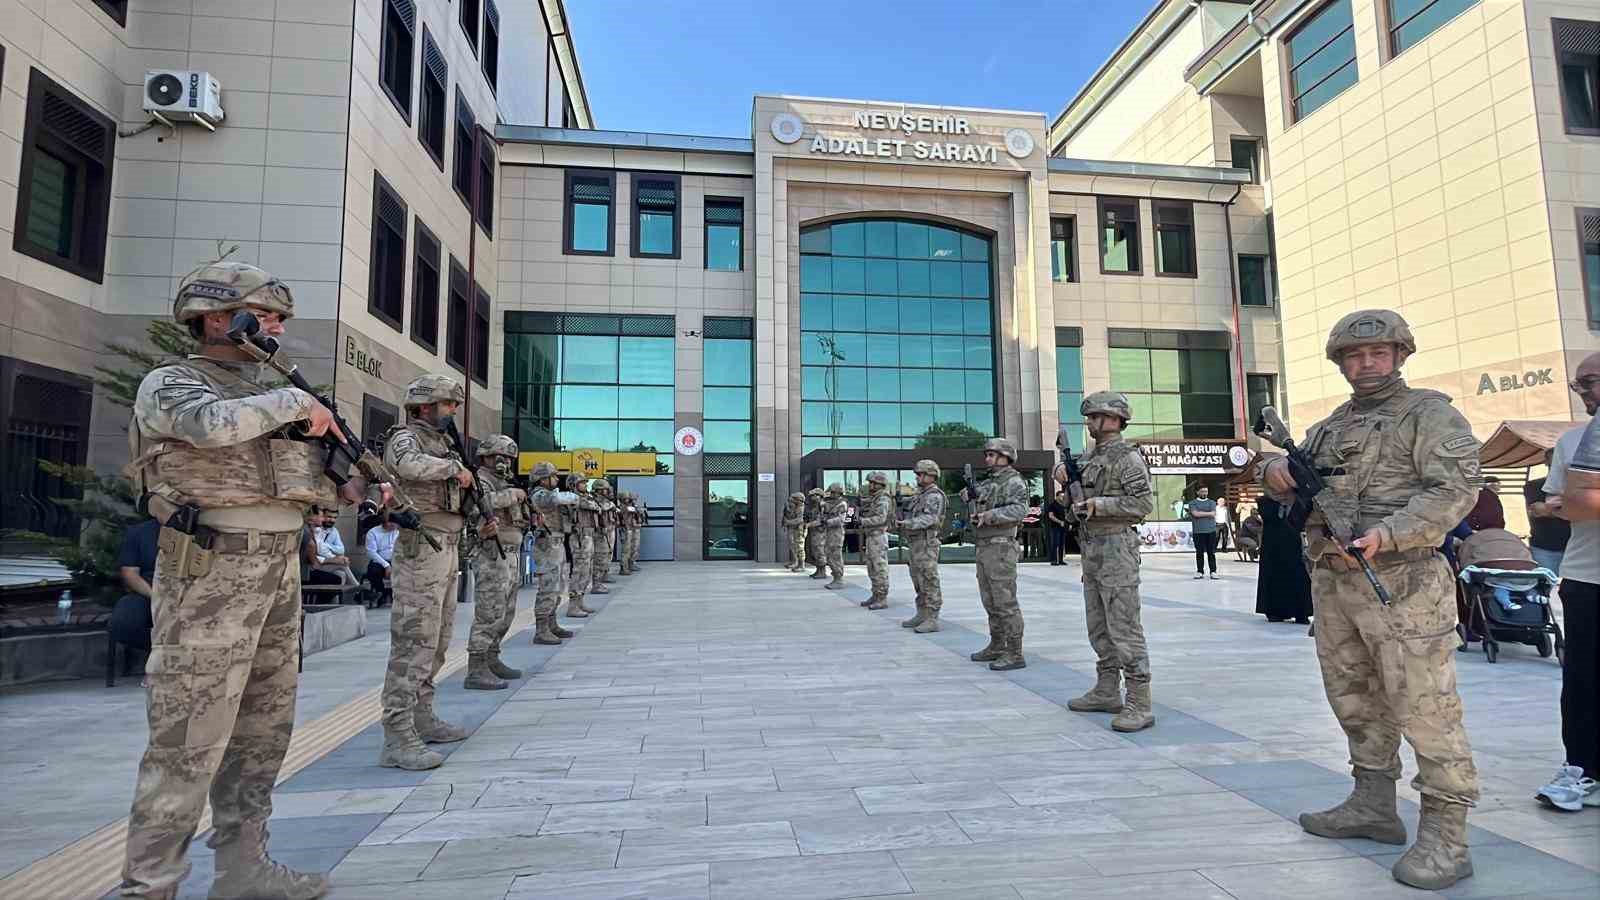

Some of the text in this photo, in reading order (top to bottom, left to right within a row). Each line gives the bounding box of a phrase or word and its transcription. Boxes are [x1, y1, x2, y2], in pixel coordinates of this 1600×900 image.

[189, 73, 199, 108] BEKO
[810, 133, 998, 163] ADALET SARAYI
[357, 351, 383, 380] BLOK
[1477, 368, 1553, 395] A BLOK
[1167, 454, 1223, 465] MAĞAZASI
[1184, 445, 1228, 454] KURUMU
